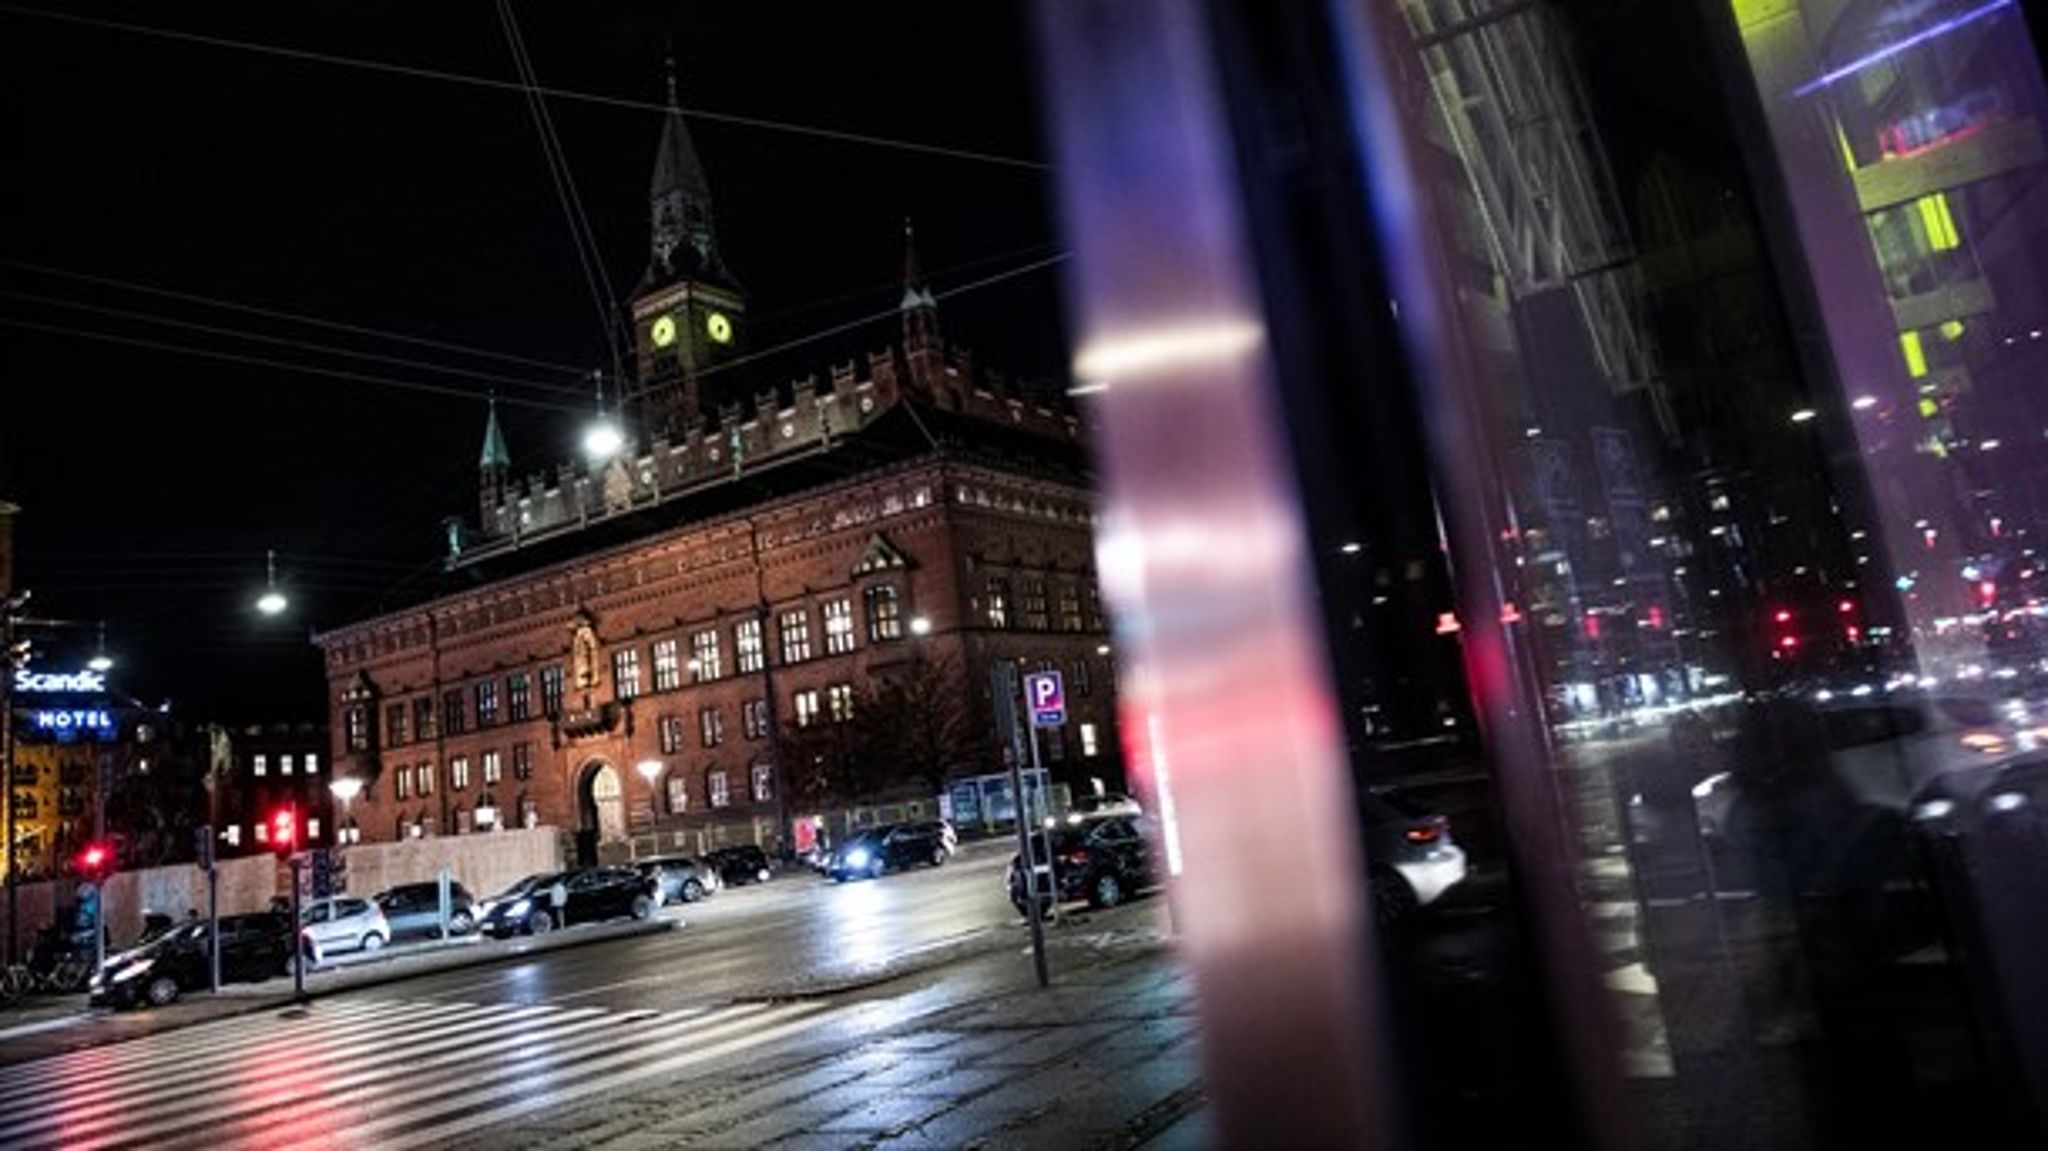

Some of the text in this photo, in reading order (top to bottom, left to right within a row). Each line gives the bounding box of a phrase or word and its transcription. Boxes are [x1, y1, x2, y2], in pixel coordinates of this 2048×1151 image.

[15, 669, 105, 692] Scandic
[1036, 677, 1055, 706] P
[39, 711, 112, 728] HOTEL
